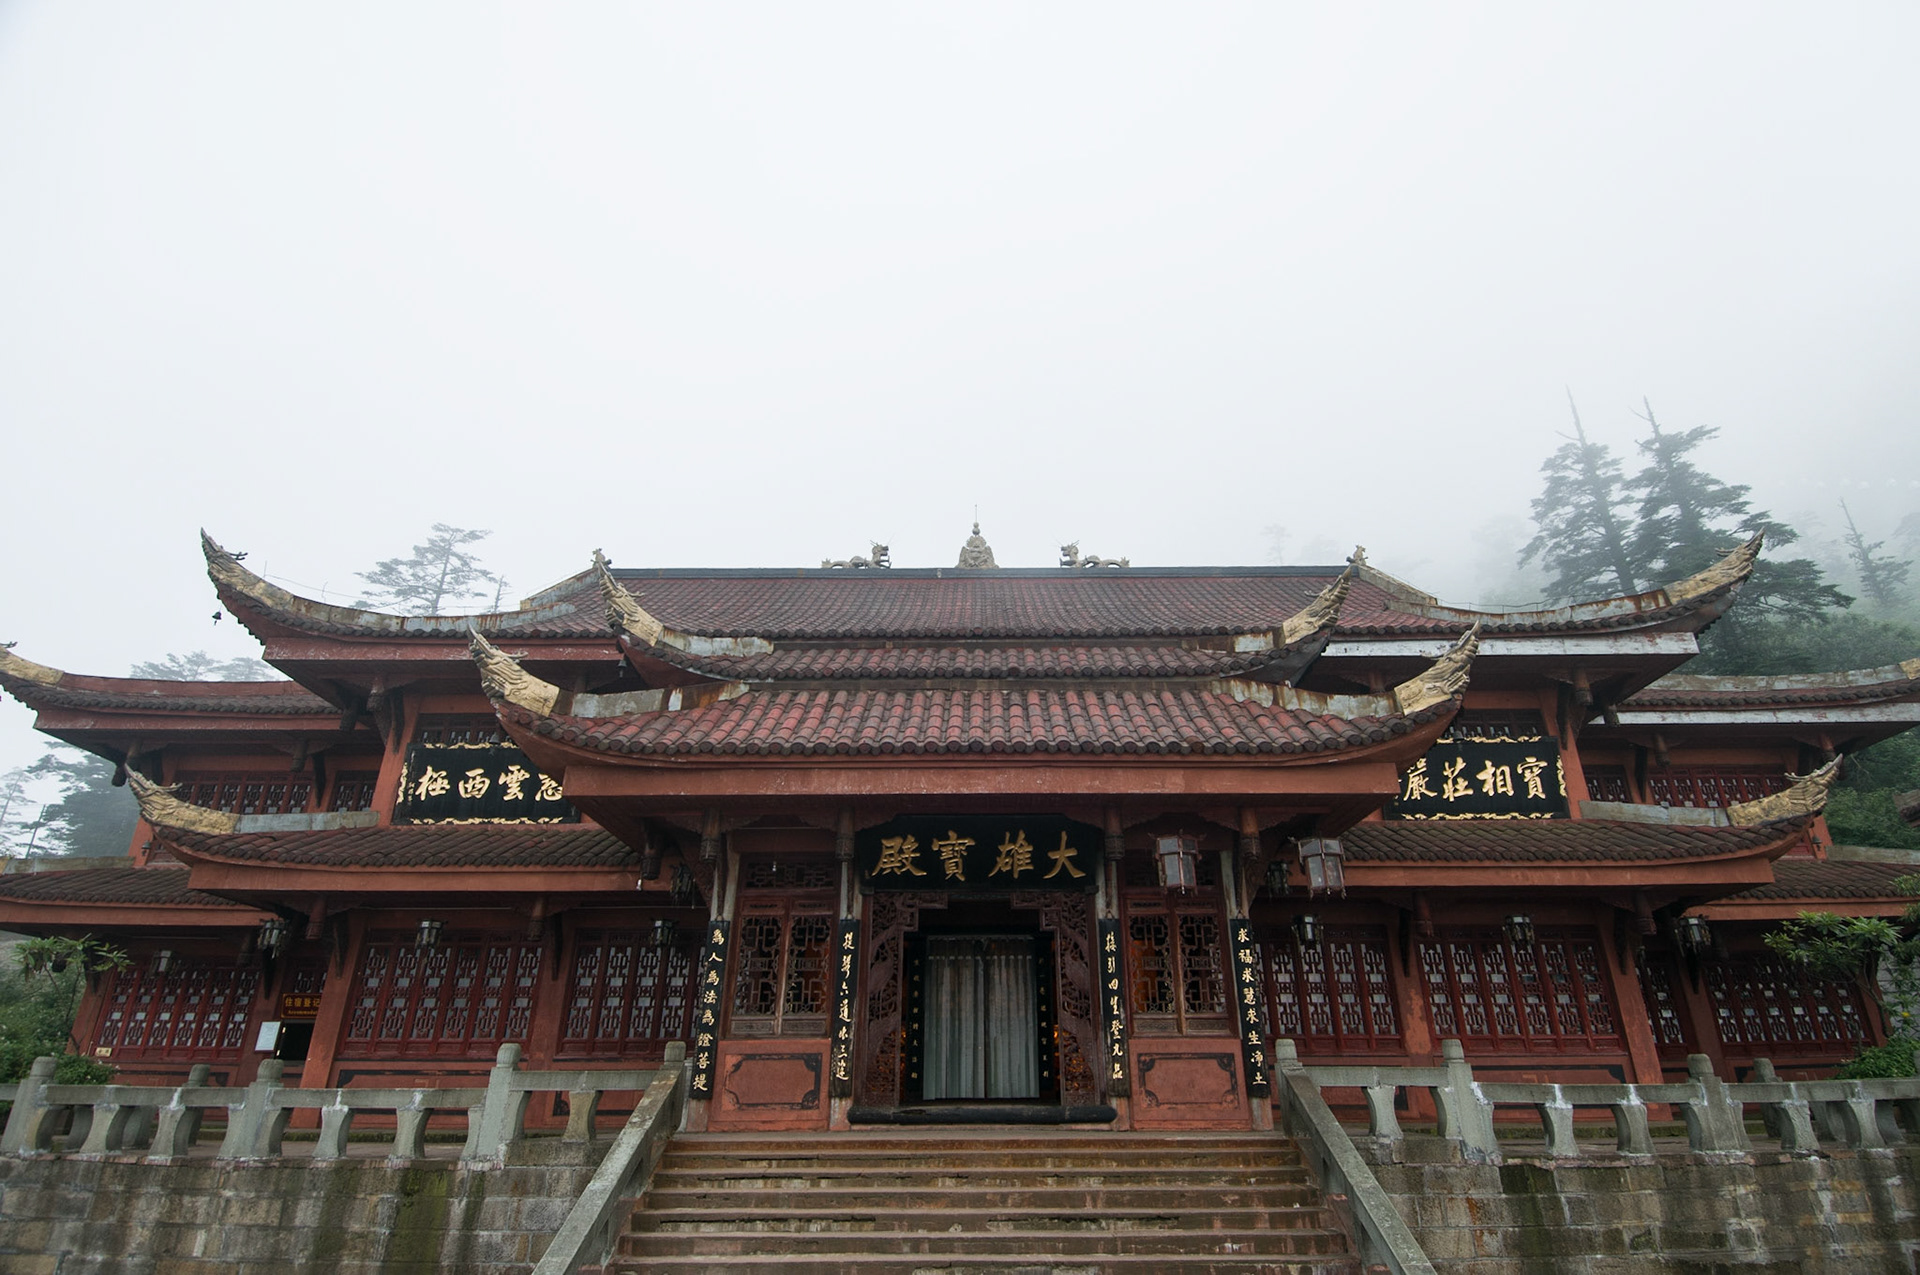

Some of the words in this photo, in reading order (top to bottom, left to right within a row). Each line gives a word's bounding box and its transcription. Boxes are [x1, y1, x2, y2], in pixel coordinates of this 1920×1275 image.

[871, 830, 1086, 881] 大雄寶殿
[285, 996, 320, 1008] 住宿登记
